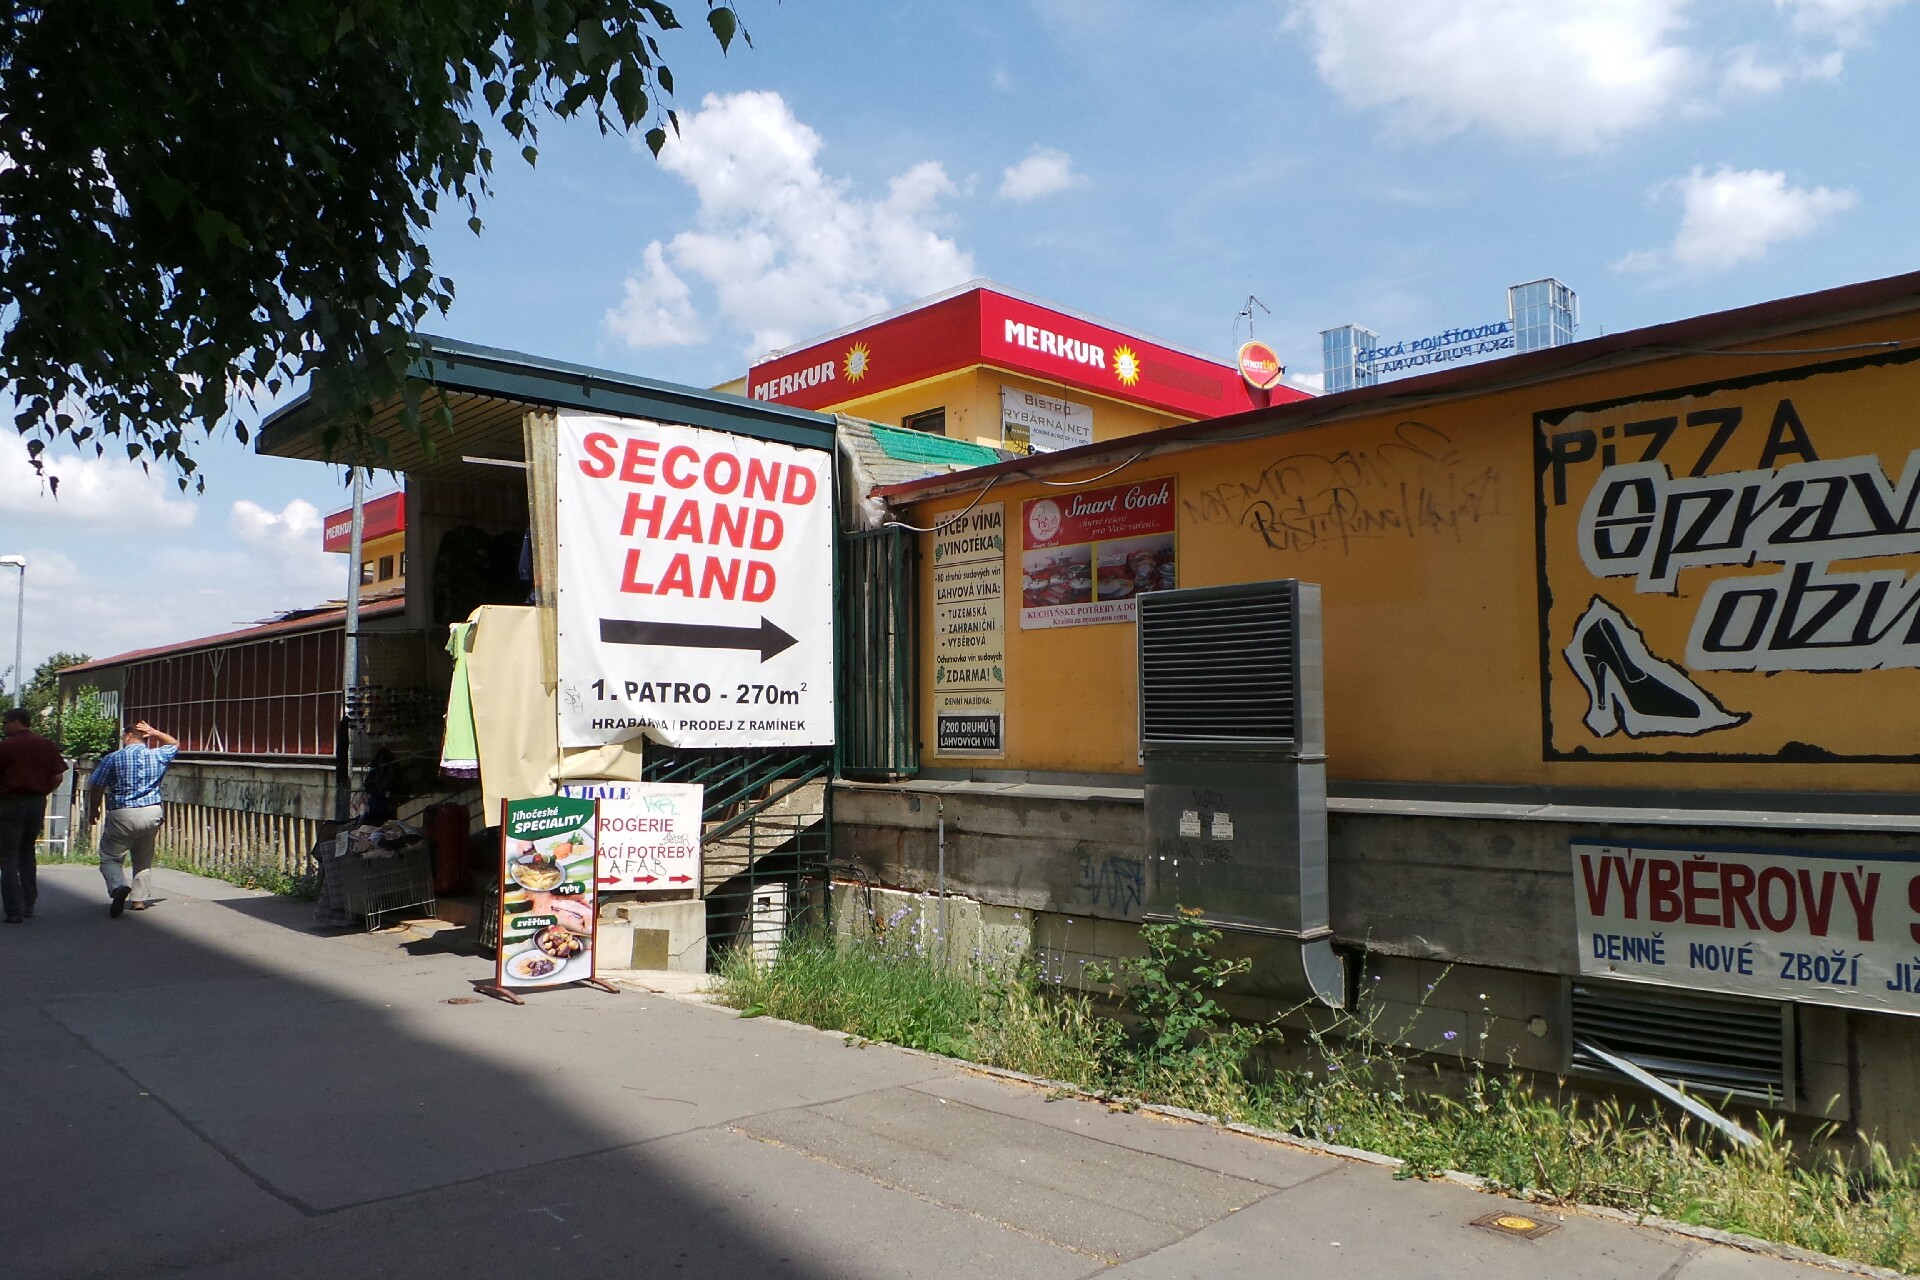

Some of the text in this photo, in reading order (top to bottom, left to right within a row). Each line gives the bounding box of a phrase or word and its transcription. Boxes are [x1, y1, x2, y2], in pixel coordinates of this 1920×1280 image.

[1004, 318, 1106, 369] MERKUR
[1357, 321, 1509, 364] ČESKÁ POJIŠŤOVNA
[754, 360, 836, 402] MERKUR
[1024, 394, 1071, 415] BISTRO
[578, 431, 817, 506] SECOND
[1064, 482, 1171, 518] Smart Cook
[619, 491, 784, 551] HAND
[935, 509, 1002, 538] VÝČEP VÍNA
[943, 532, 994, 556] VINOTÉKA
[619, 547, 777, 603] LAND
[937, 580, 1001, 600] LAHVOVÁ VÍNA:
[948, 602, 987, 619] TUZEMSKÁ
[1077, 603, 1116, 615] POTŘEBY
[948, 617, 995, 634] ZAHRANIČNÍ
[946, 667, 990, 683] ZDARMA!
[591, 678, 618, 701] 1.
[624, 679, 711, 705] PATRO
[944, 694, 963, 706] DENNÍ
[591, 714, 669, 731] HRABÁRNA
[679, 719, 733, 732] PRODEJ
[736, 719, 746, 731] Z
[749, 717, 806, 731] RAMÍNEK
[945, 718, 989, 733] 200 DRUHŮ
[940, 733, 996, 747] LAHVOVÝCH VÍN
[581, 786, 631, 800] HALE
[514, 814, 584, 834] SPECIALITY
[627, 843, 695, 859] POTŘEBY
[559, 884, 581, 895] ryby
[1580, 847, 1881, 942] VÝBĚROVÝ
[1592, 931, 1666, 966] DENNĚ
[1689, 941, 1754, 976] NOVÉ
[1779, 949, 1864, 987] ZBOŽÍ
